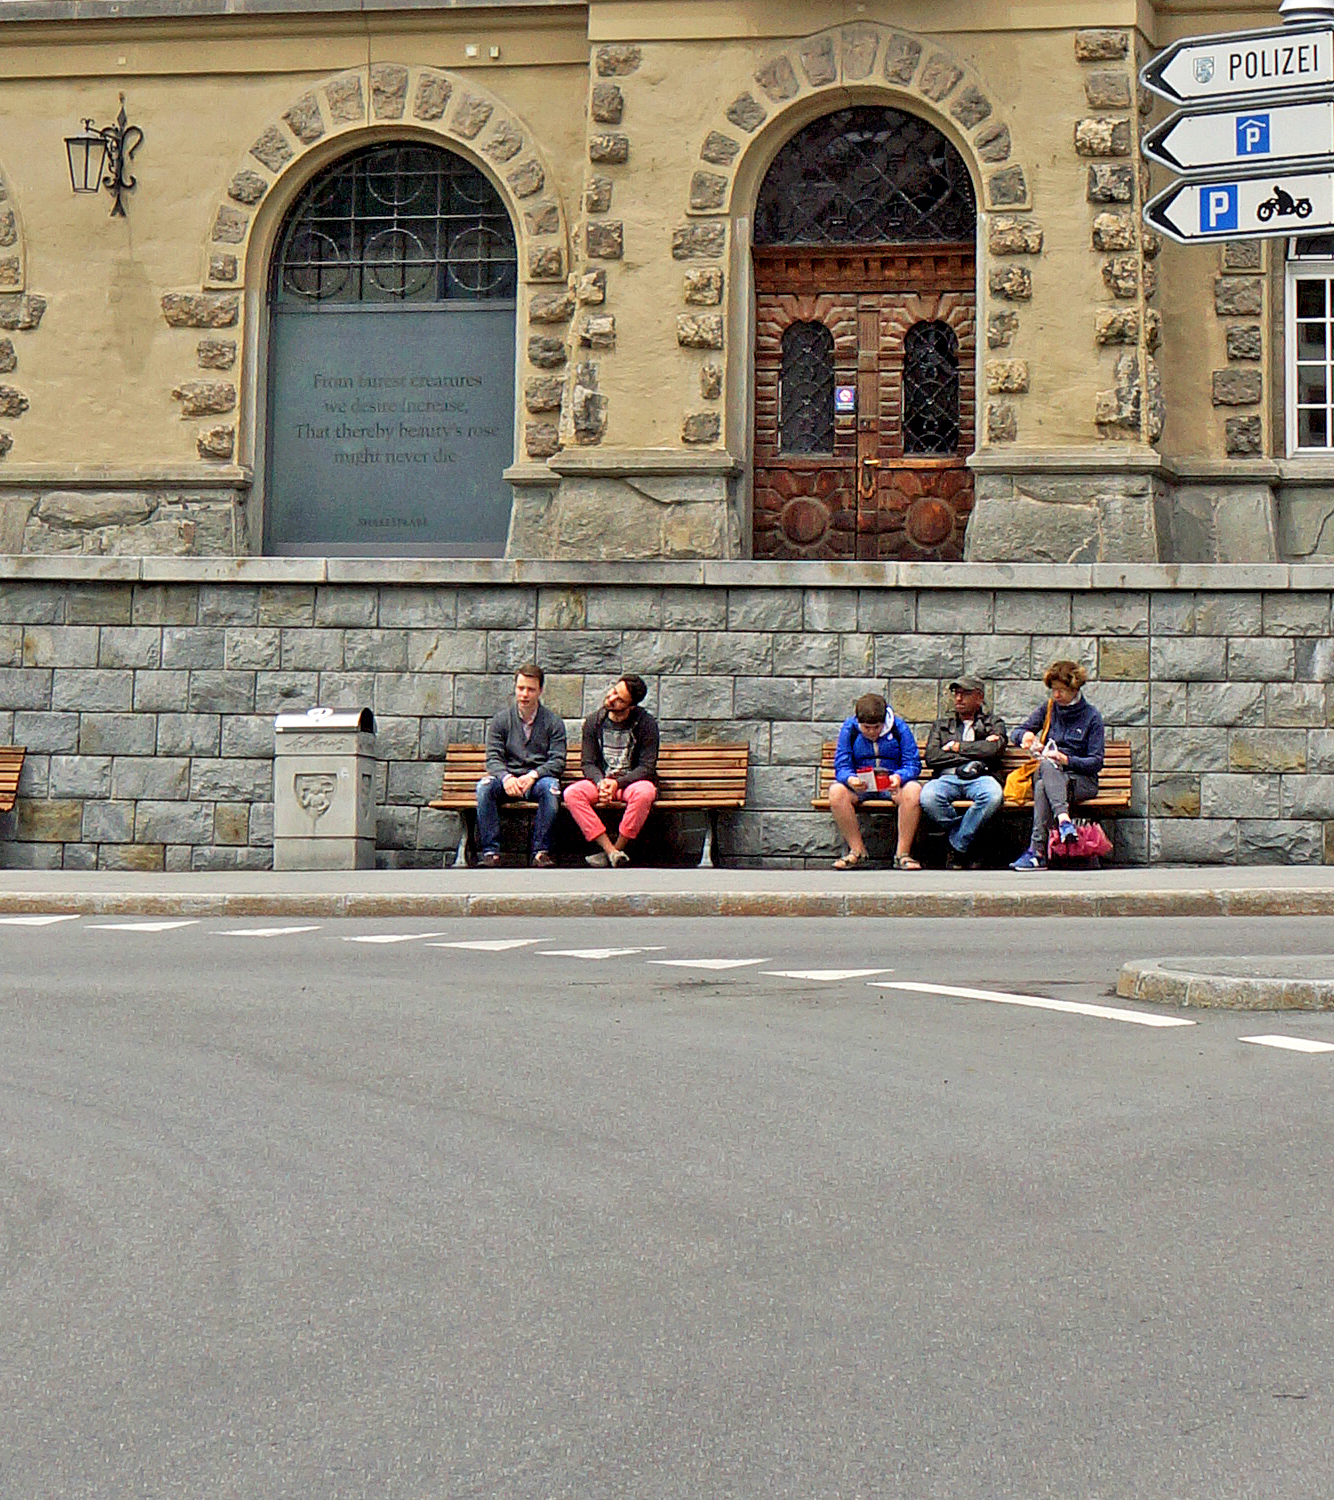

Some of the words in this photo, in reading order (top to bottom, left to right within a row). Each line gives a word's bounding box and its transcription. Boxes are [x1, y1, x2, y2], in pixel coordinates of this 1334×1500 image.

[1230, 44, 1318, 81] POLIZEI
[1246, 127, 1260, 152] P
[1209, 191, 1229, 227] P
